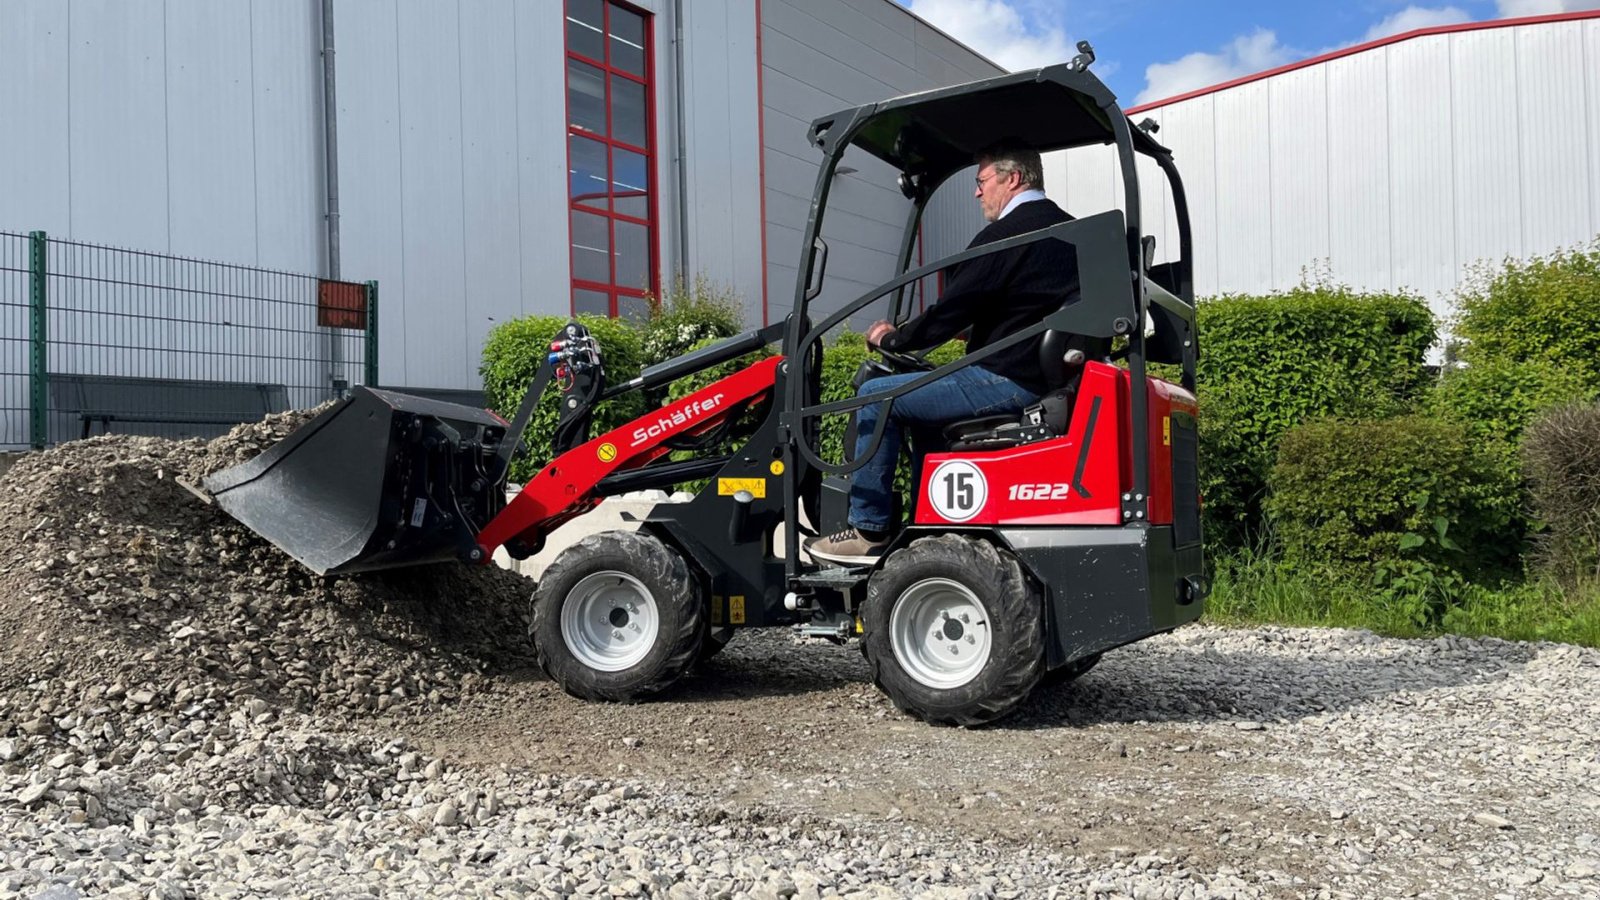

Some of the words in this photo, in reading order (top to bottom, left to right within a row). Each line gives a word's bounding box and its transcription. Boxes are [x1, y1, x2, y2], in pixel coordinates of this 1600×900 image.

[630, 393, 724, 447] Schäffer
[943, 473, 974, 510] 15
[1008, 483, 1069, 500] 1622
